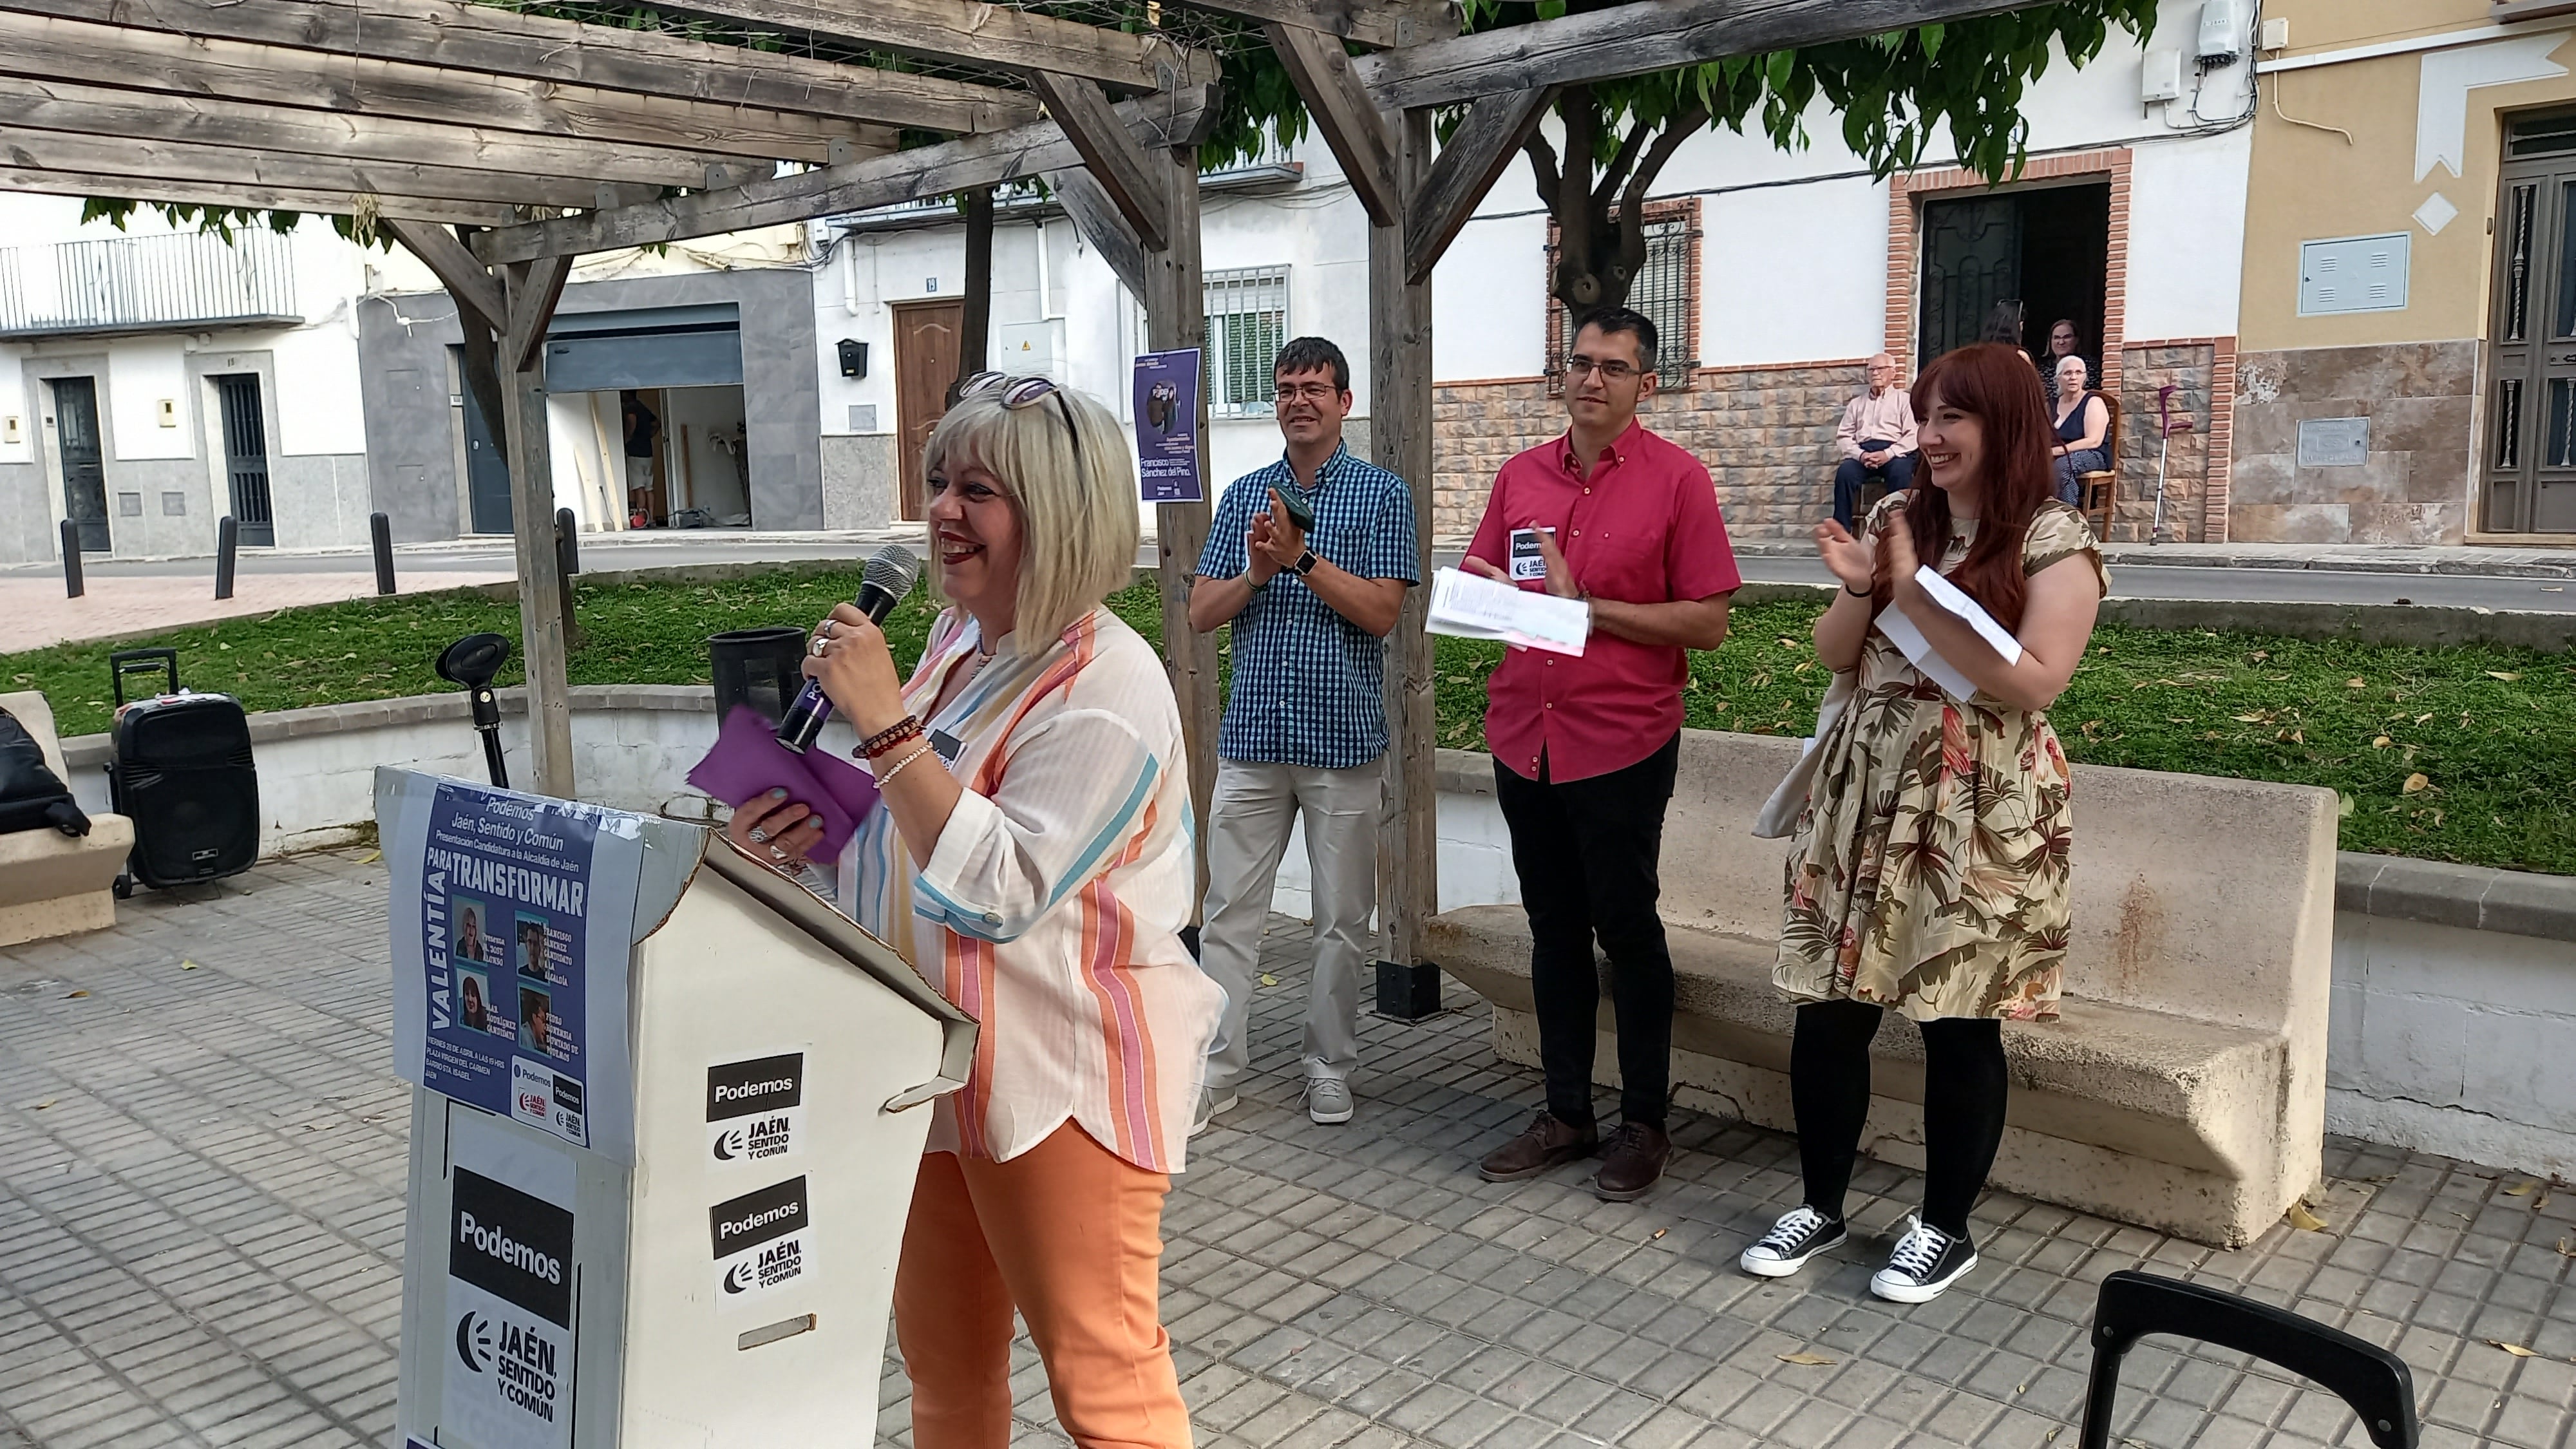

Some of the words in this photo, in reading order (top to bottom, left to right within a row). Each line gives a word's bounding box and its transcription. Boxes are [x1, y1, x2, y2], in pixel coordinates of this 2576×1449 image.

[928, 278, 935, 291] 19
[1141, 457, 1169, 468] Francisco
[1141, 467, 1168, 478] Sánchez
[1515, 542, 1541, 551] Podem
[1530, 558, 1545, 567] JAÉ
[806, 683, 821, 701] PO
[486, 797, 535, 821] Podemos
[451, 811, 476, 835] Jaén,
[478, 817, 516, 841] Sentido
[516, 829, 526, 846] y
[524, 828, 564, 852] Común
[436, 829, 473, 848] Presentación
[474, 839, 511, 857] Candidatura
[516, 848, 522, 860] la
[523, 851, 549, 867] Alcaldía
[550, 858, 560, 868] de
[560, 860, 579, 873] Jaén
[427, 847, 451, 872] PARA
[452, 851, 584, 918] TRANSFORMAR
[424, 870, 452, 1030] VALENTÍA
[426, 1046, 441, 1058] PLAZA
[459, 1058, 468, 1068] DEL
[452, 1045, 459, 1054] DE
[478, 1054, 489, 1063] LAS
[522, 1069, 551, 1088] Podemos
[714, 1076, 793, 1103] Podemos
[555, 1086, 580, 1104] Podemos
[748, 1115, 791, 1139] JAÉN,
[748, 1133, 790, 1150] SENTDO
[748, 1151, 755, 1160] Y
[719, 1200, 799, 1240] Podemos
[459, 1210, 562, 1285] Podemos
[757, 1256, 802, 1280] SENTIDO
[759, 1279, 766, 1289] Y
[766, 1267, 802, 1287] COMÚN
[498, 1320, 557, 1379] JAÉN,
[497, 1355, 556, 1401] SENTIDO
[497, 1377, 506, 1397] Y
[506, 1383, 554, 1423] COMÚN
